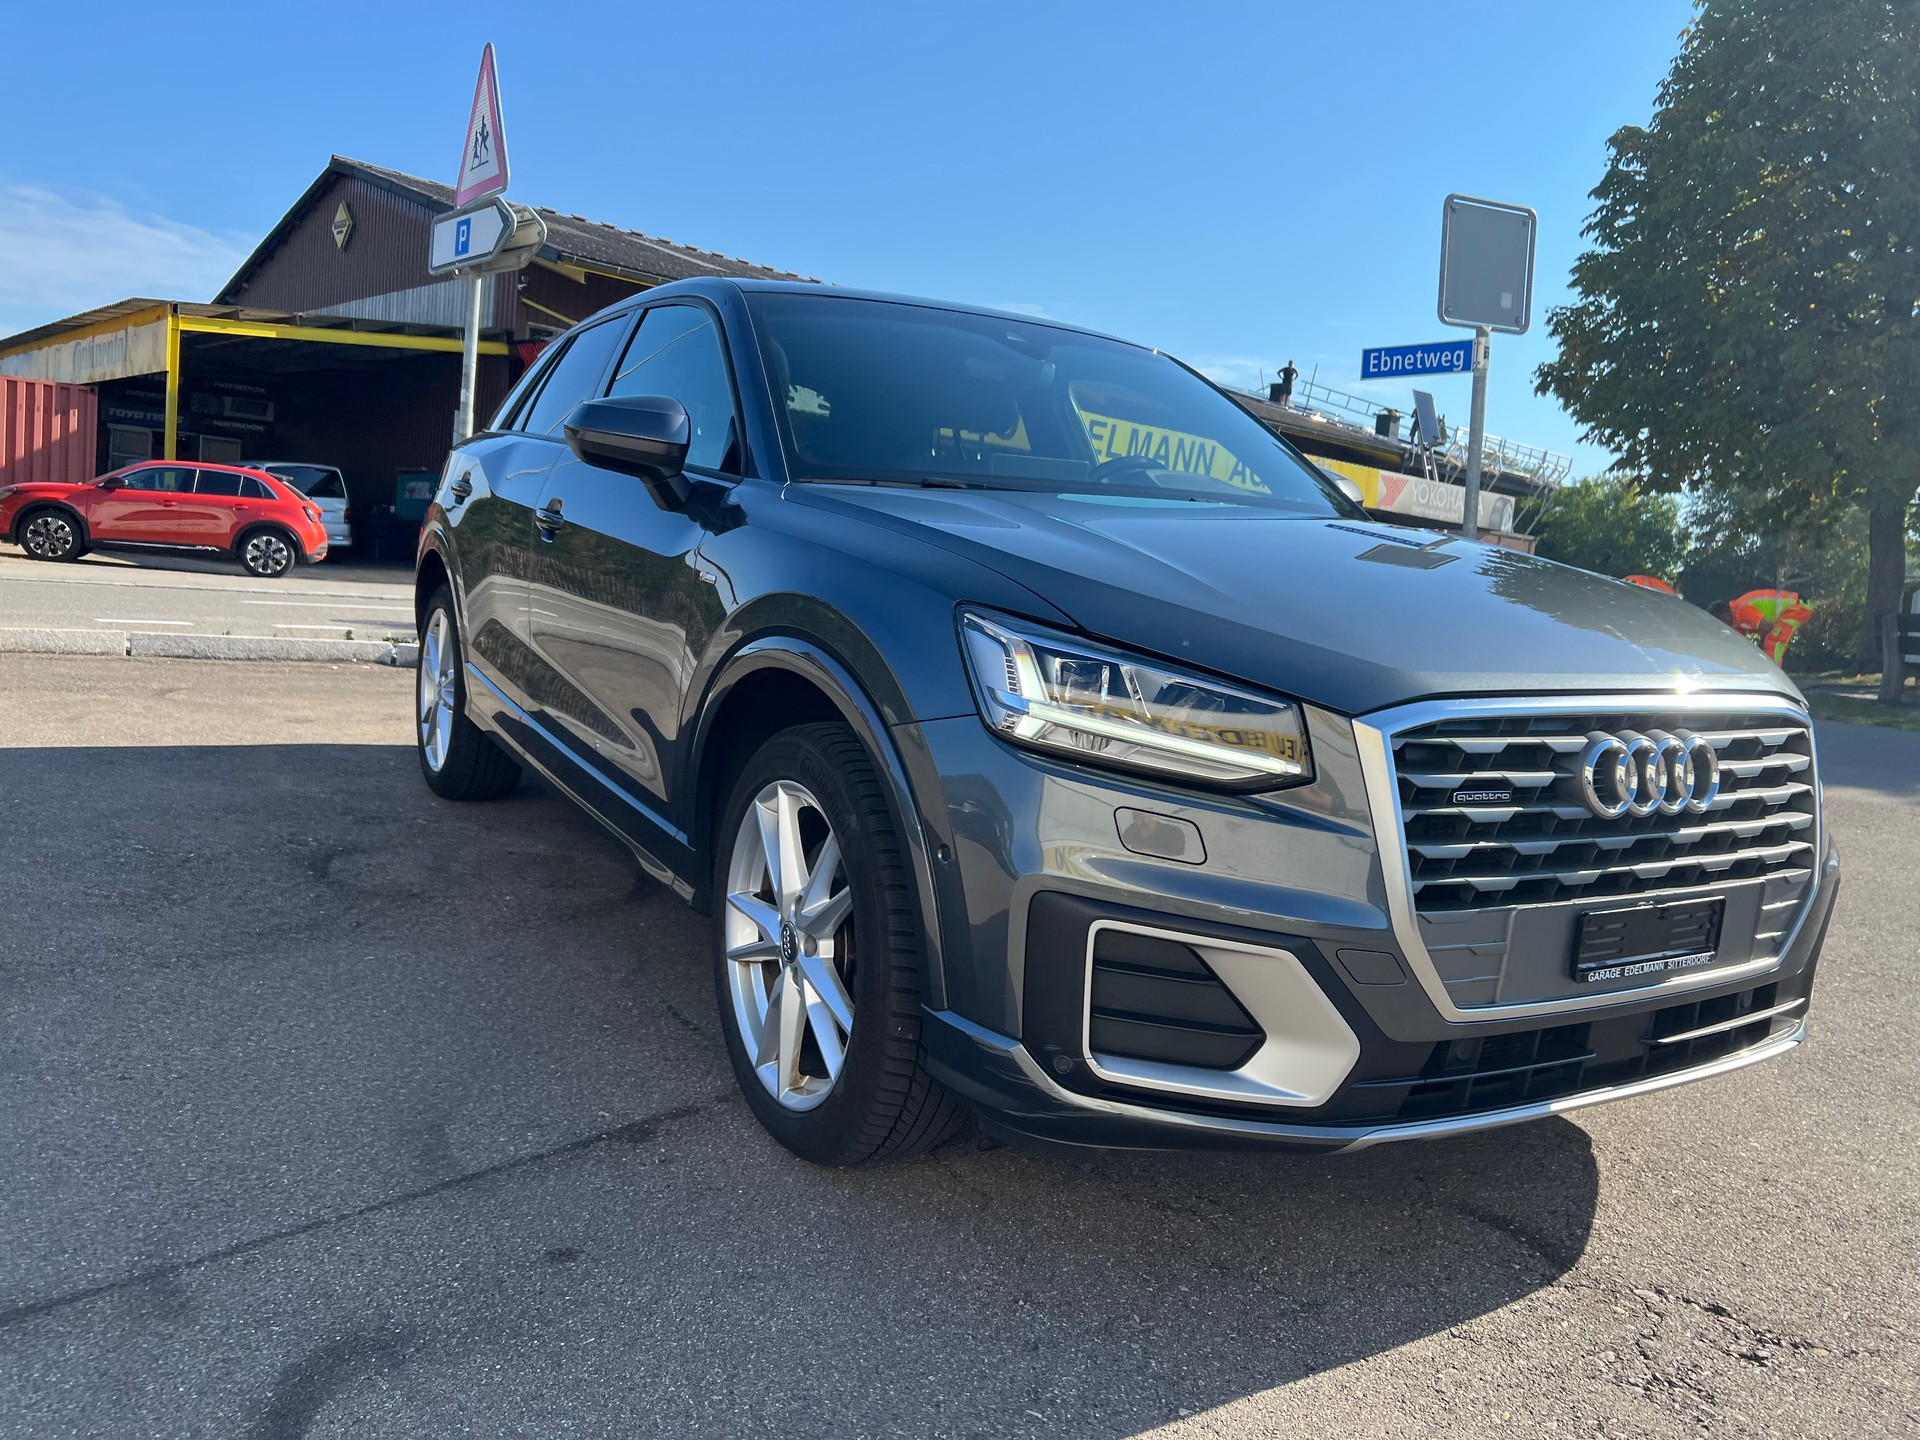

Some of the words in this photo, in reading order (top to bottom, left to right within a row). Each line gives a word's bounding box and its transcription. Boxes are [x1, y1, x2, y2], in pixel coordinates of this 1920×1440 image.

[458, 225, 467, 251] P
[1369, 349, 1465, 373] Ebnetweg
[108, 407, 144, 419] TOYO
[1412, 481, 1483, 515] YOKOHAA
[1457, 792, 1510, 802] quattro
[1588, 968, 1621, 982] GARAGE
[1624, 961, 1664, 976] EDELMANN
[1667, 954, 1712, 969] SITTERDORF
